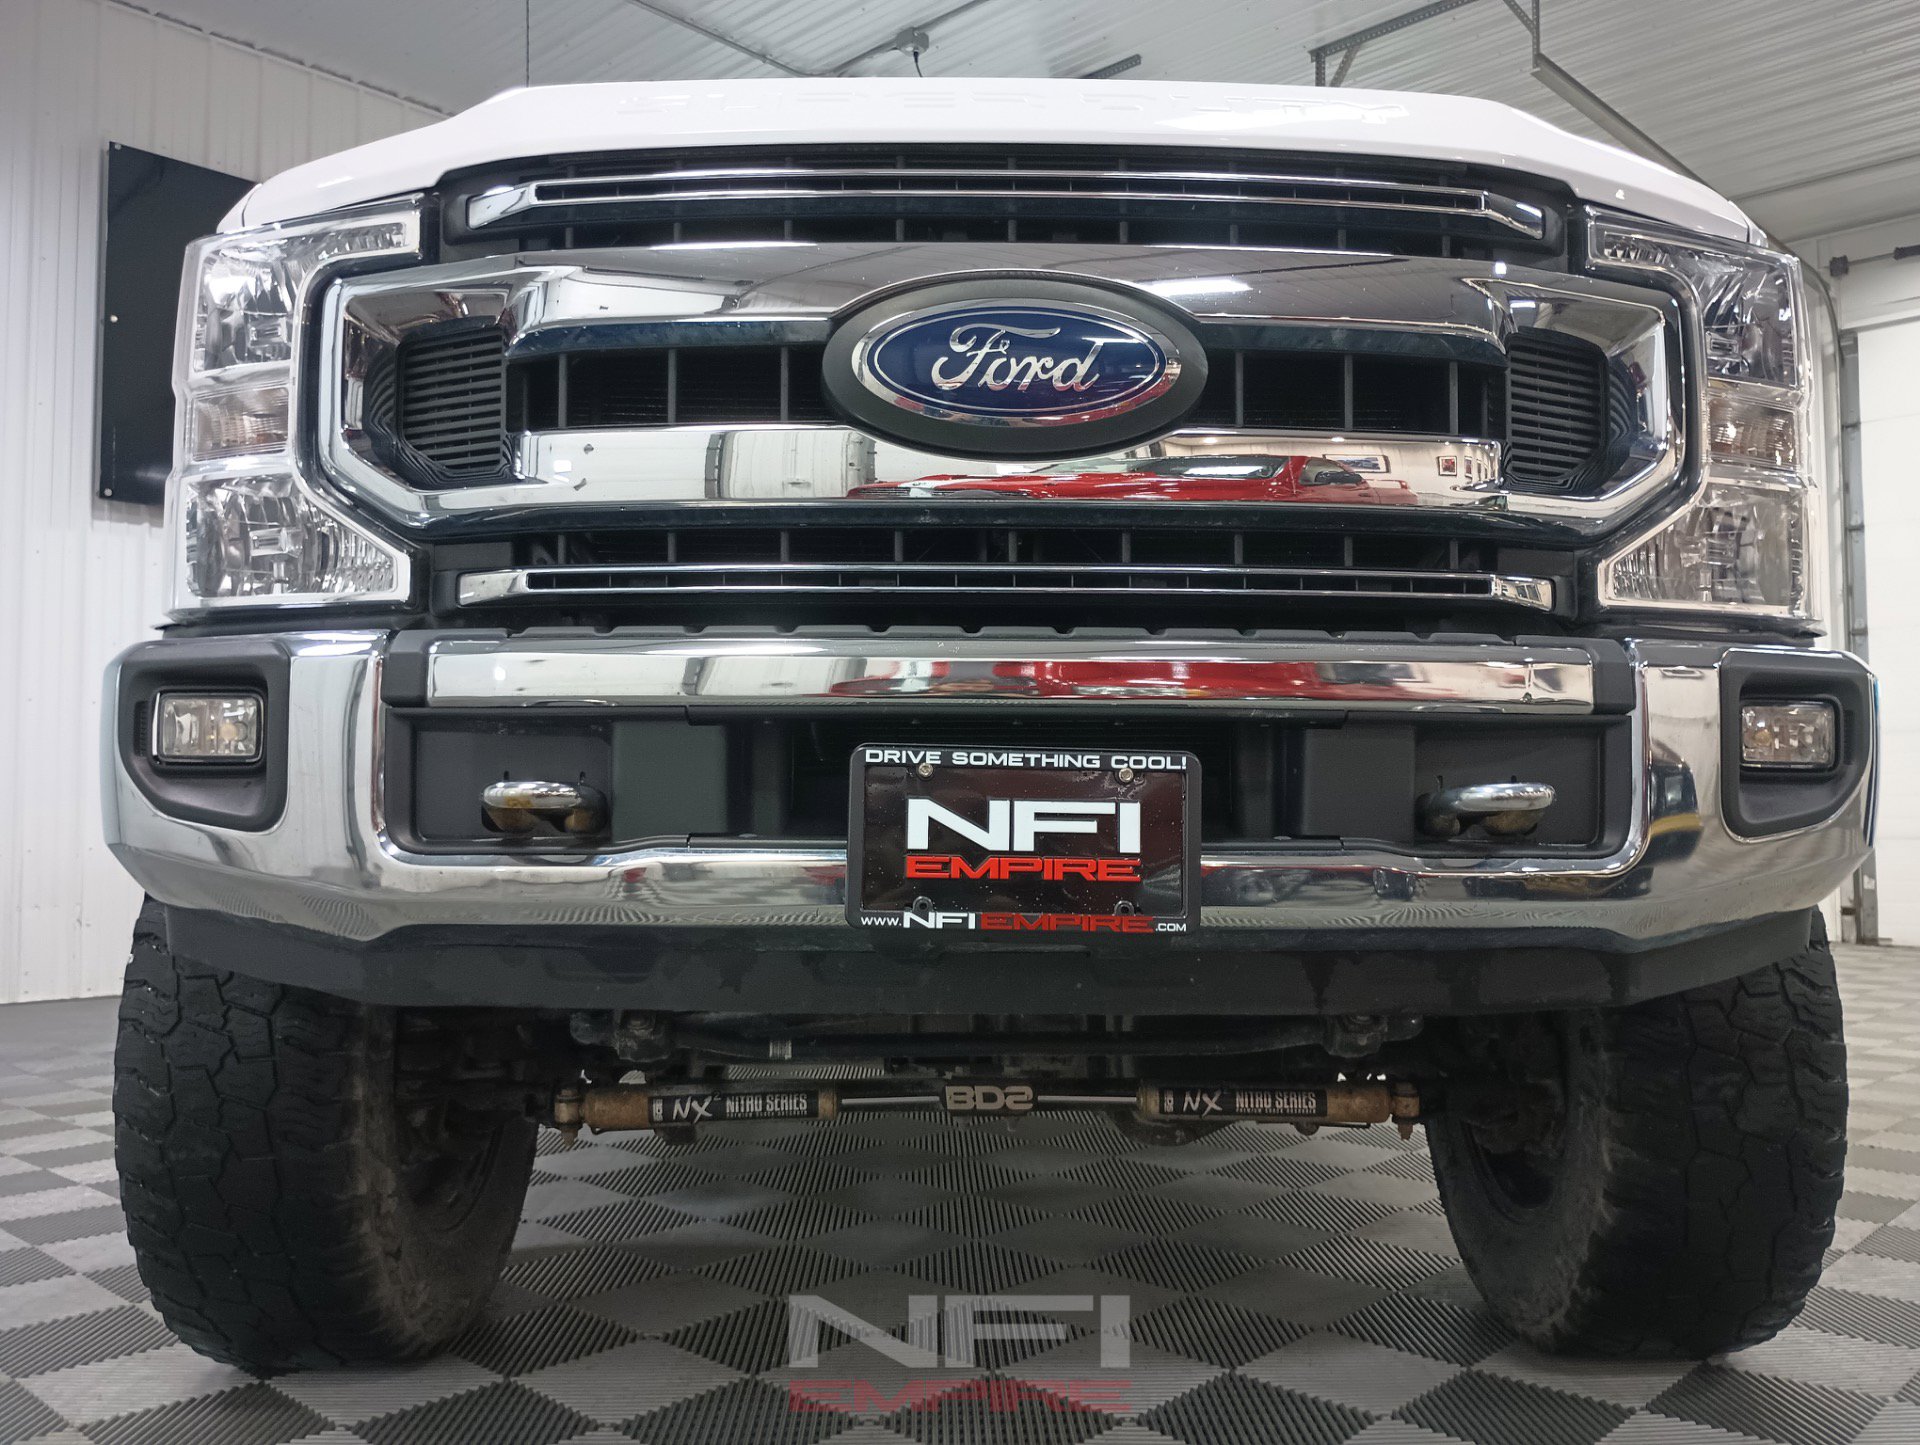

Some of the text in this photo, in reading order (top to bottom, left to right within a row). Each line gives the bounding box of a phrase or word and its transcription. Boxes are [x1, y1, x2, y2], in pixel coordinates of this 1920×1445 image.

[931, 323, 1105, 392] Ford
[865, 749, 1187, 770] DRIVE SOMETHING COOL!
[907, 798, 1141, 853] NFI
[906, 855, 1142, 882] EMPIRE
[726, 1095, 762, 1113] NITRO
[766, 1093, 808, 1112] SERIES
[1236, 1091, 1272, 1109] NITRO
[1275, 1091, 1317, 1109] SERIES
